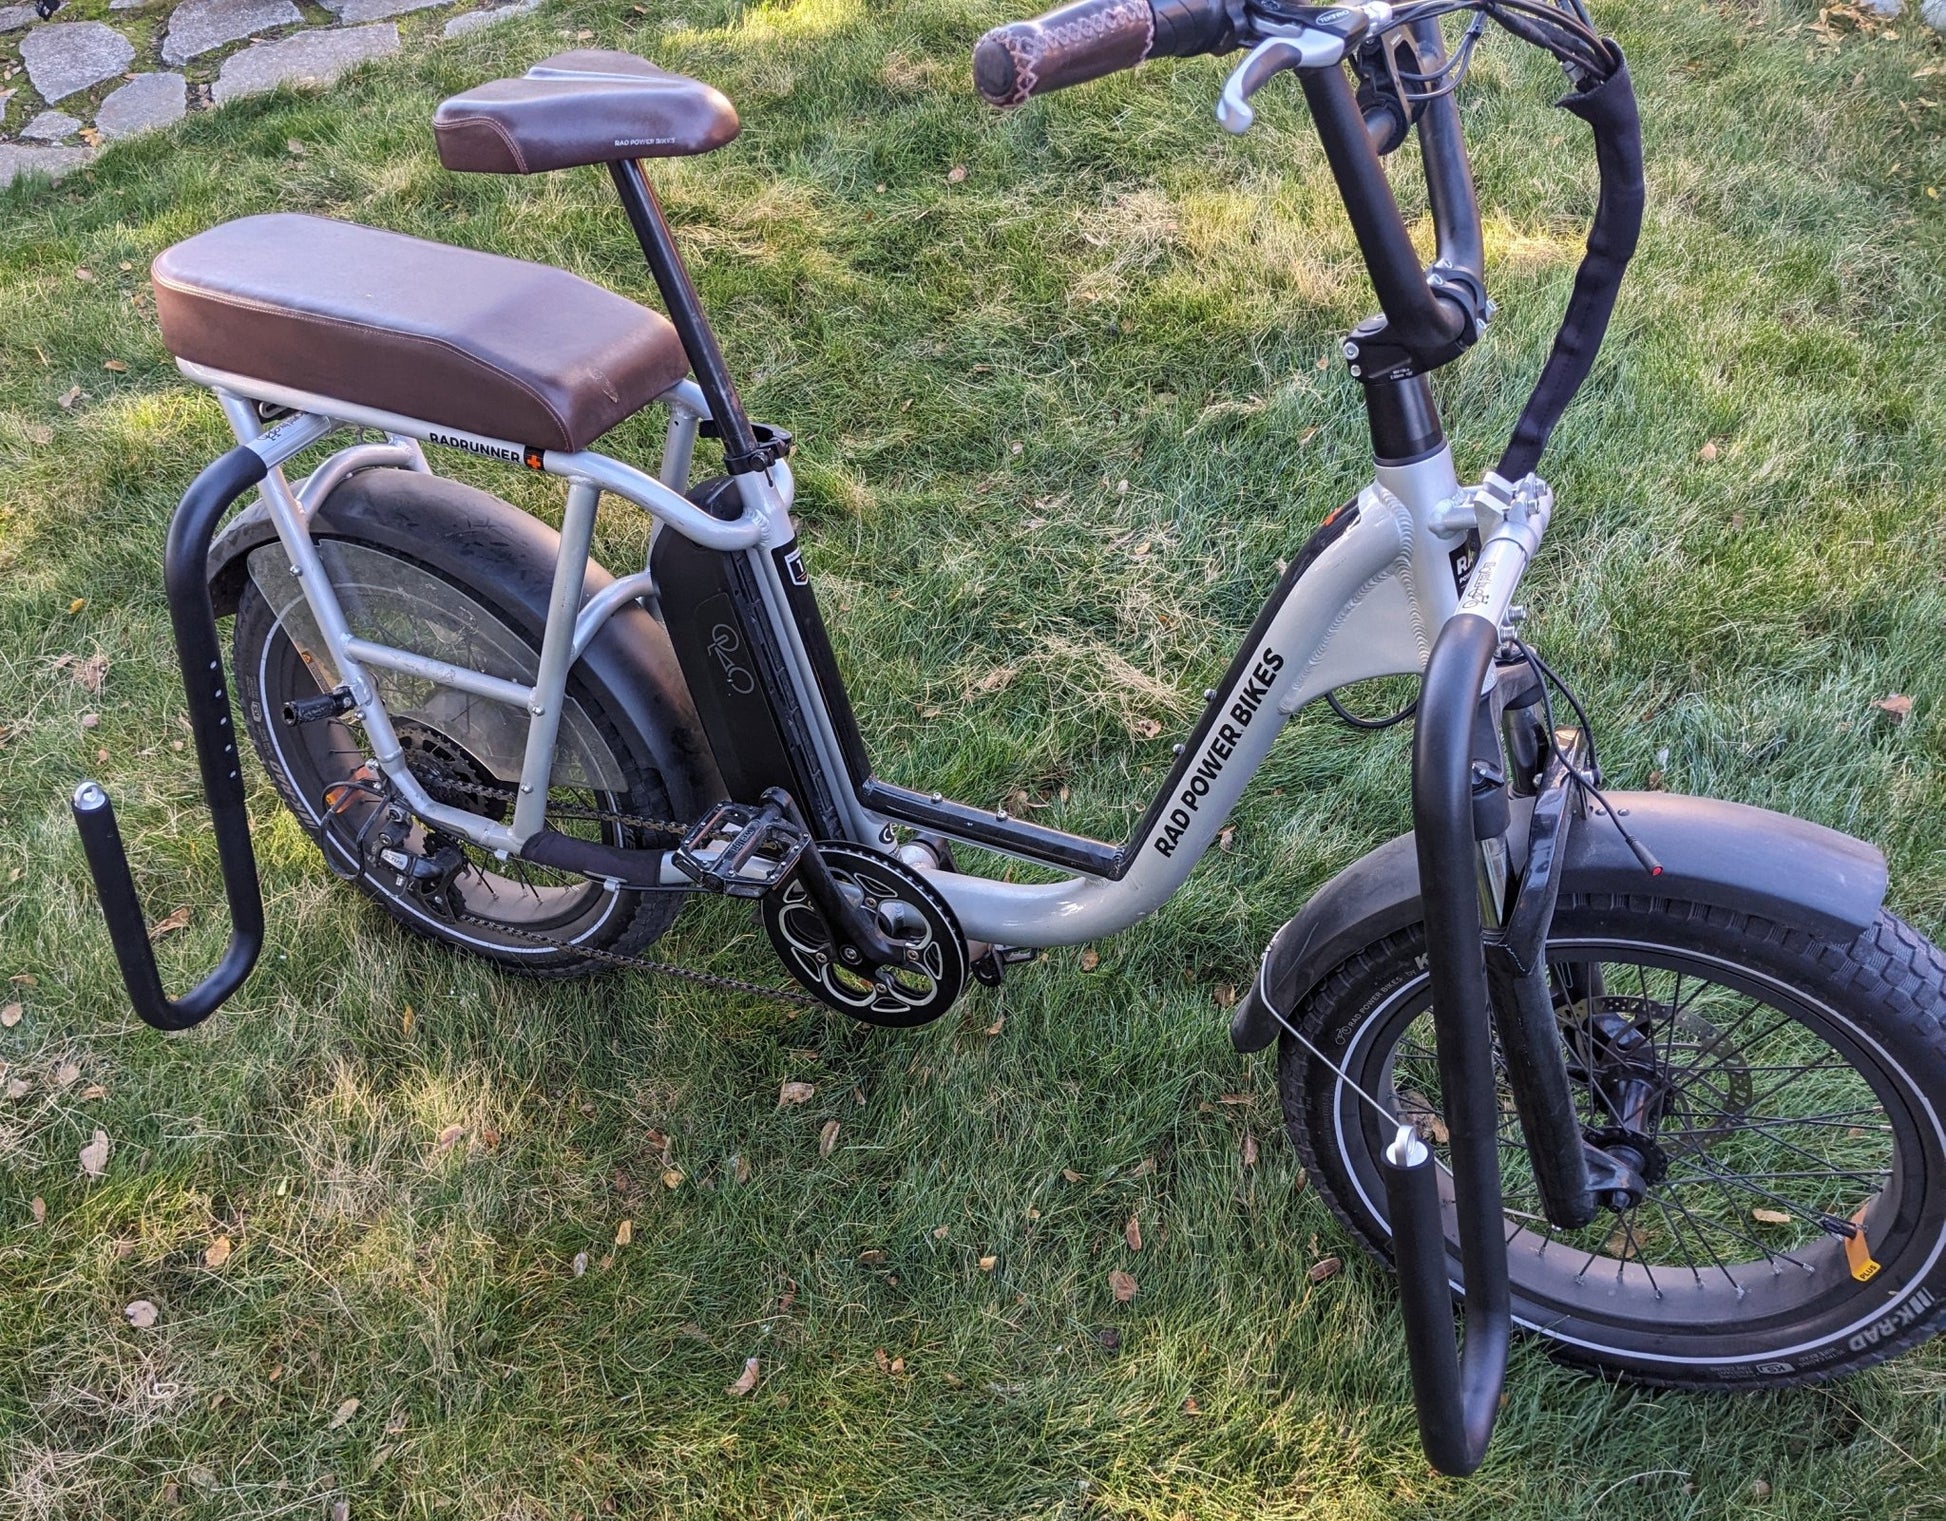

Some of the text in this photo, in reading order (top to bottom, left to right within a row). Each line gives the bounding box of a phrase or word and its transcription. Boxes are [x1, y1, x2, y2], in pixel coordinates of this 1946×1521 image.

[429, 432, 520, 462] RADRUNNER
[1154, 647, 1284, 857] RAD POWER BIKES
[1348, 1013, 1362, 1028] RAD
[1360, 991, 1383, 1014] POWER
[1380, 977, 1403, 993] BIKES
[1859, 1264, 1877, 1280] PLUS
